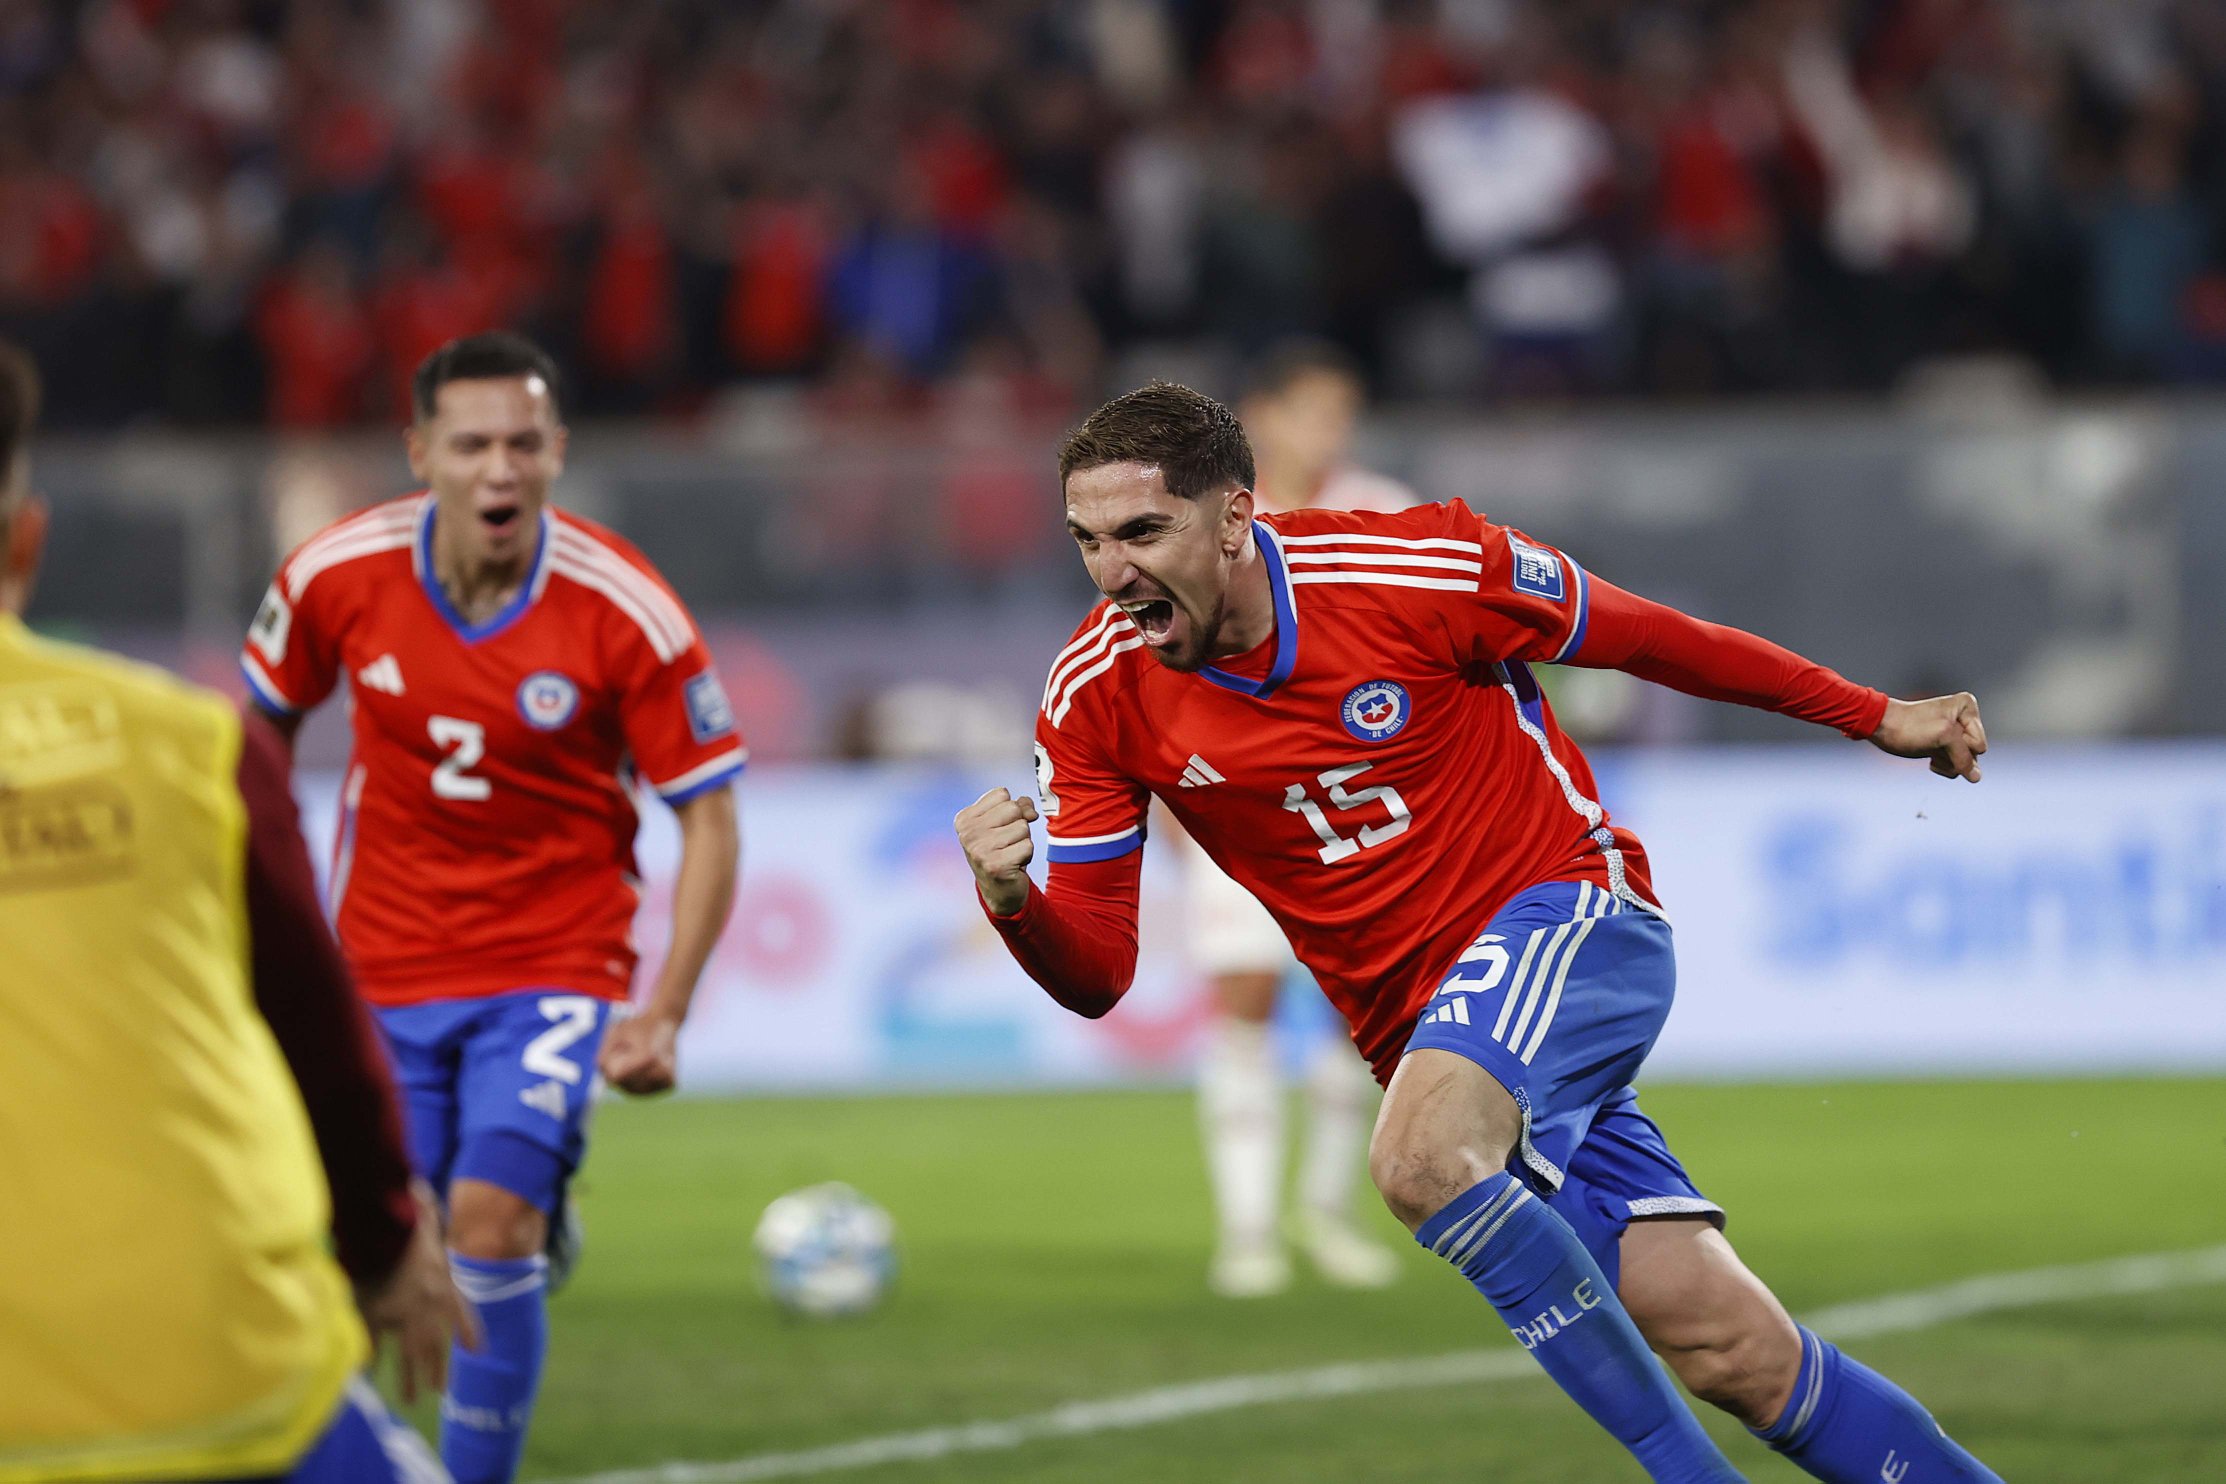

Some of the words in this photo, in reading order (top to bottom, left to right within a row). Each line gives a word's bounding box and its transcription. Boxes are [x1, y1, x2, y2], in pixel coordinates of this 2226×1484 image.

[427, 713, 492, 802] 2
[1372, 730, 1382, 738] DE
[1385, 718, 1403, 734] CHILE
[1282, 760, 1412, 865] 15
[1429, 933, 1510, 1002] 5
[521, 995, 598, 1087] 2
[1510, 1276, 1602, 1350] CHILE
